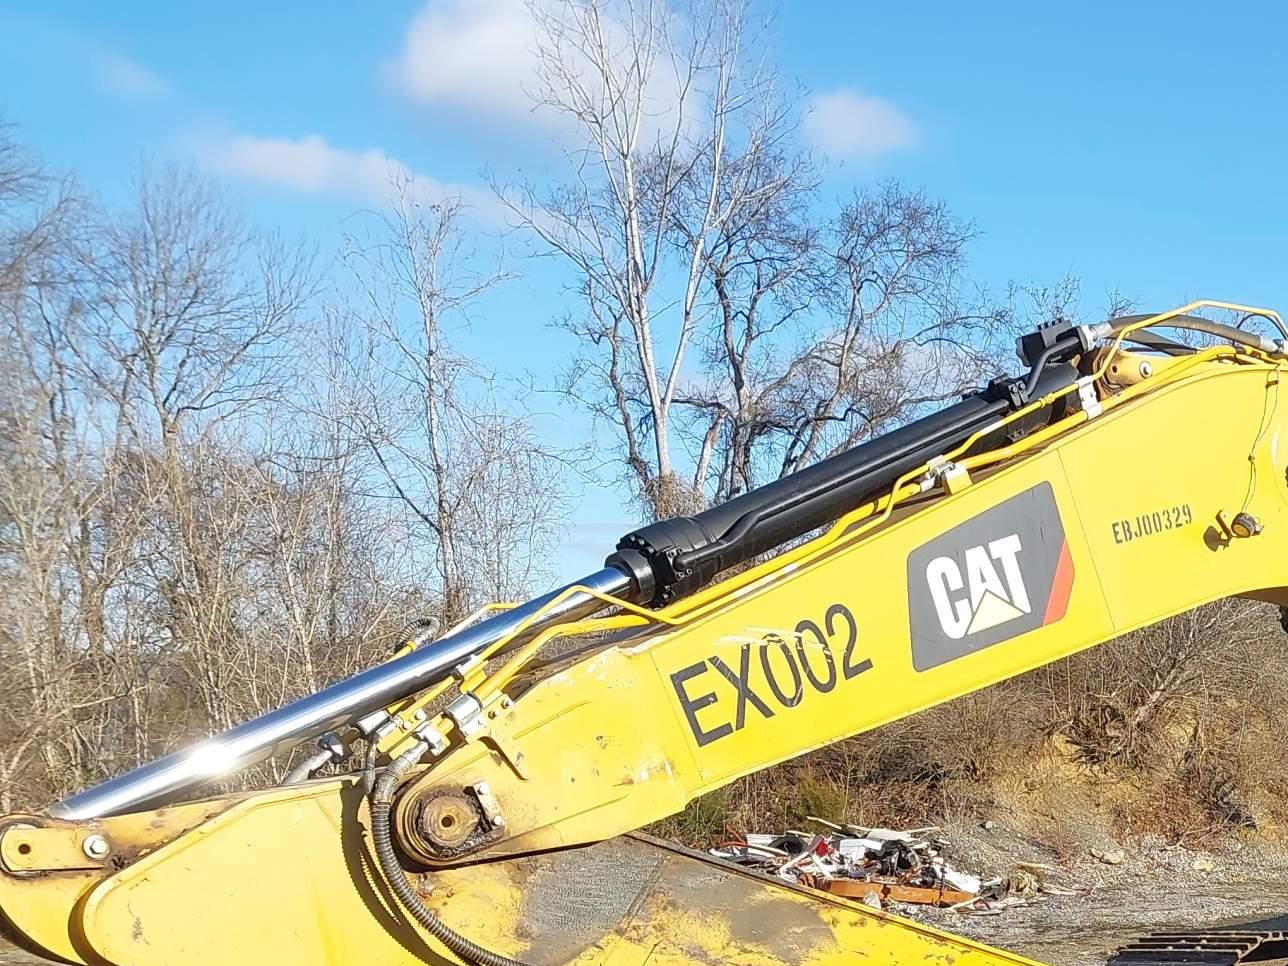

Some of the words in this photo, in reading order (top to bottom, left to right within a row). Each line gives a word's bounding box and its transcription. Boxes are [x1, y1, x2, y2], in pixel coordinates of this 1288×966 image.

[1112, 504, 1193, 544] EBJ00329
[926, 534, 1032, 639] CAT
[670, 604, 873, 747] EX002
